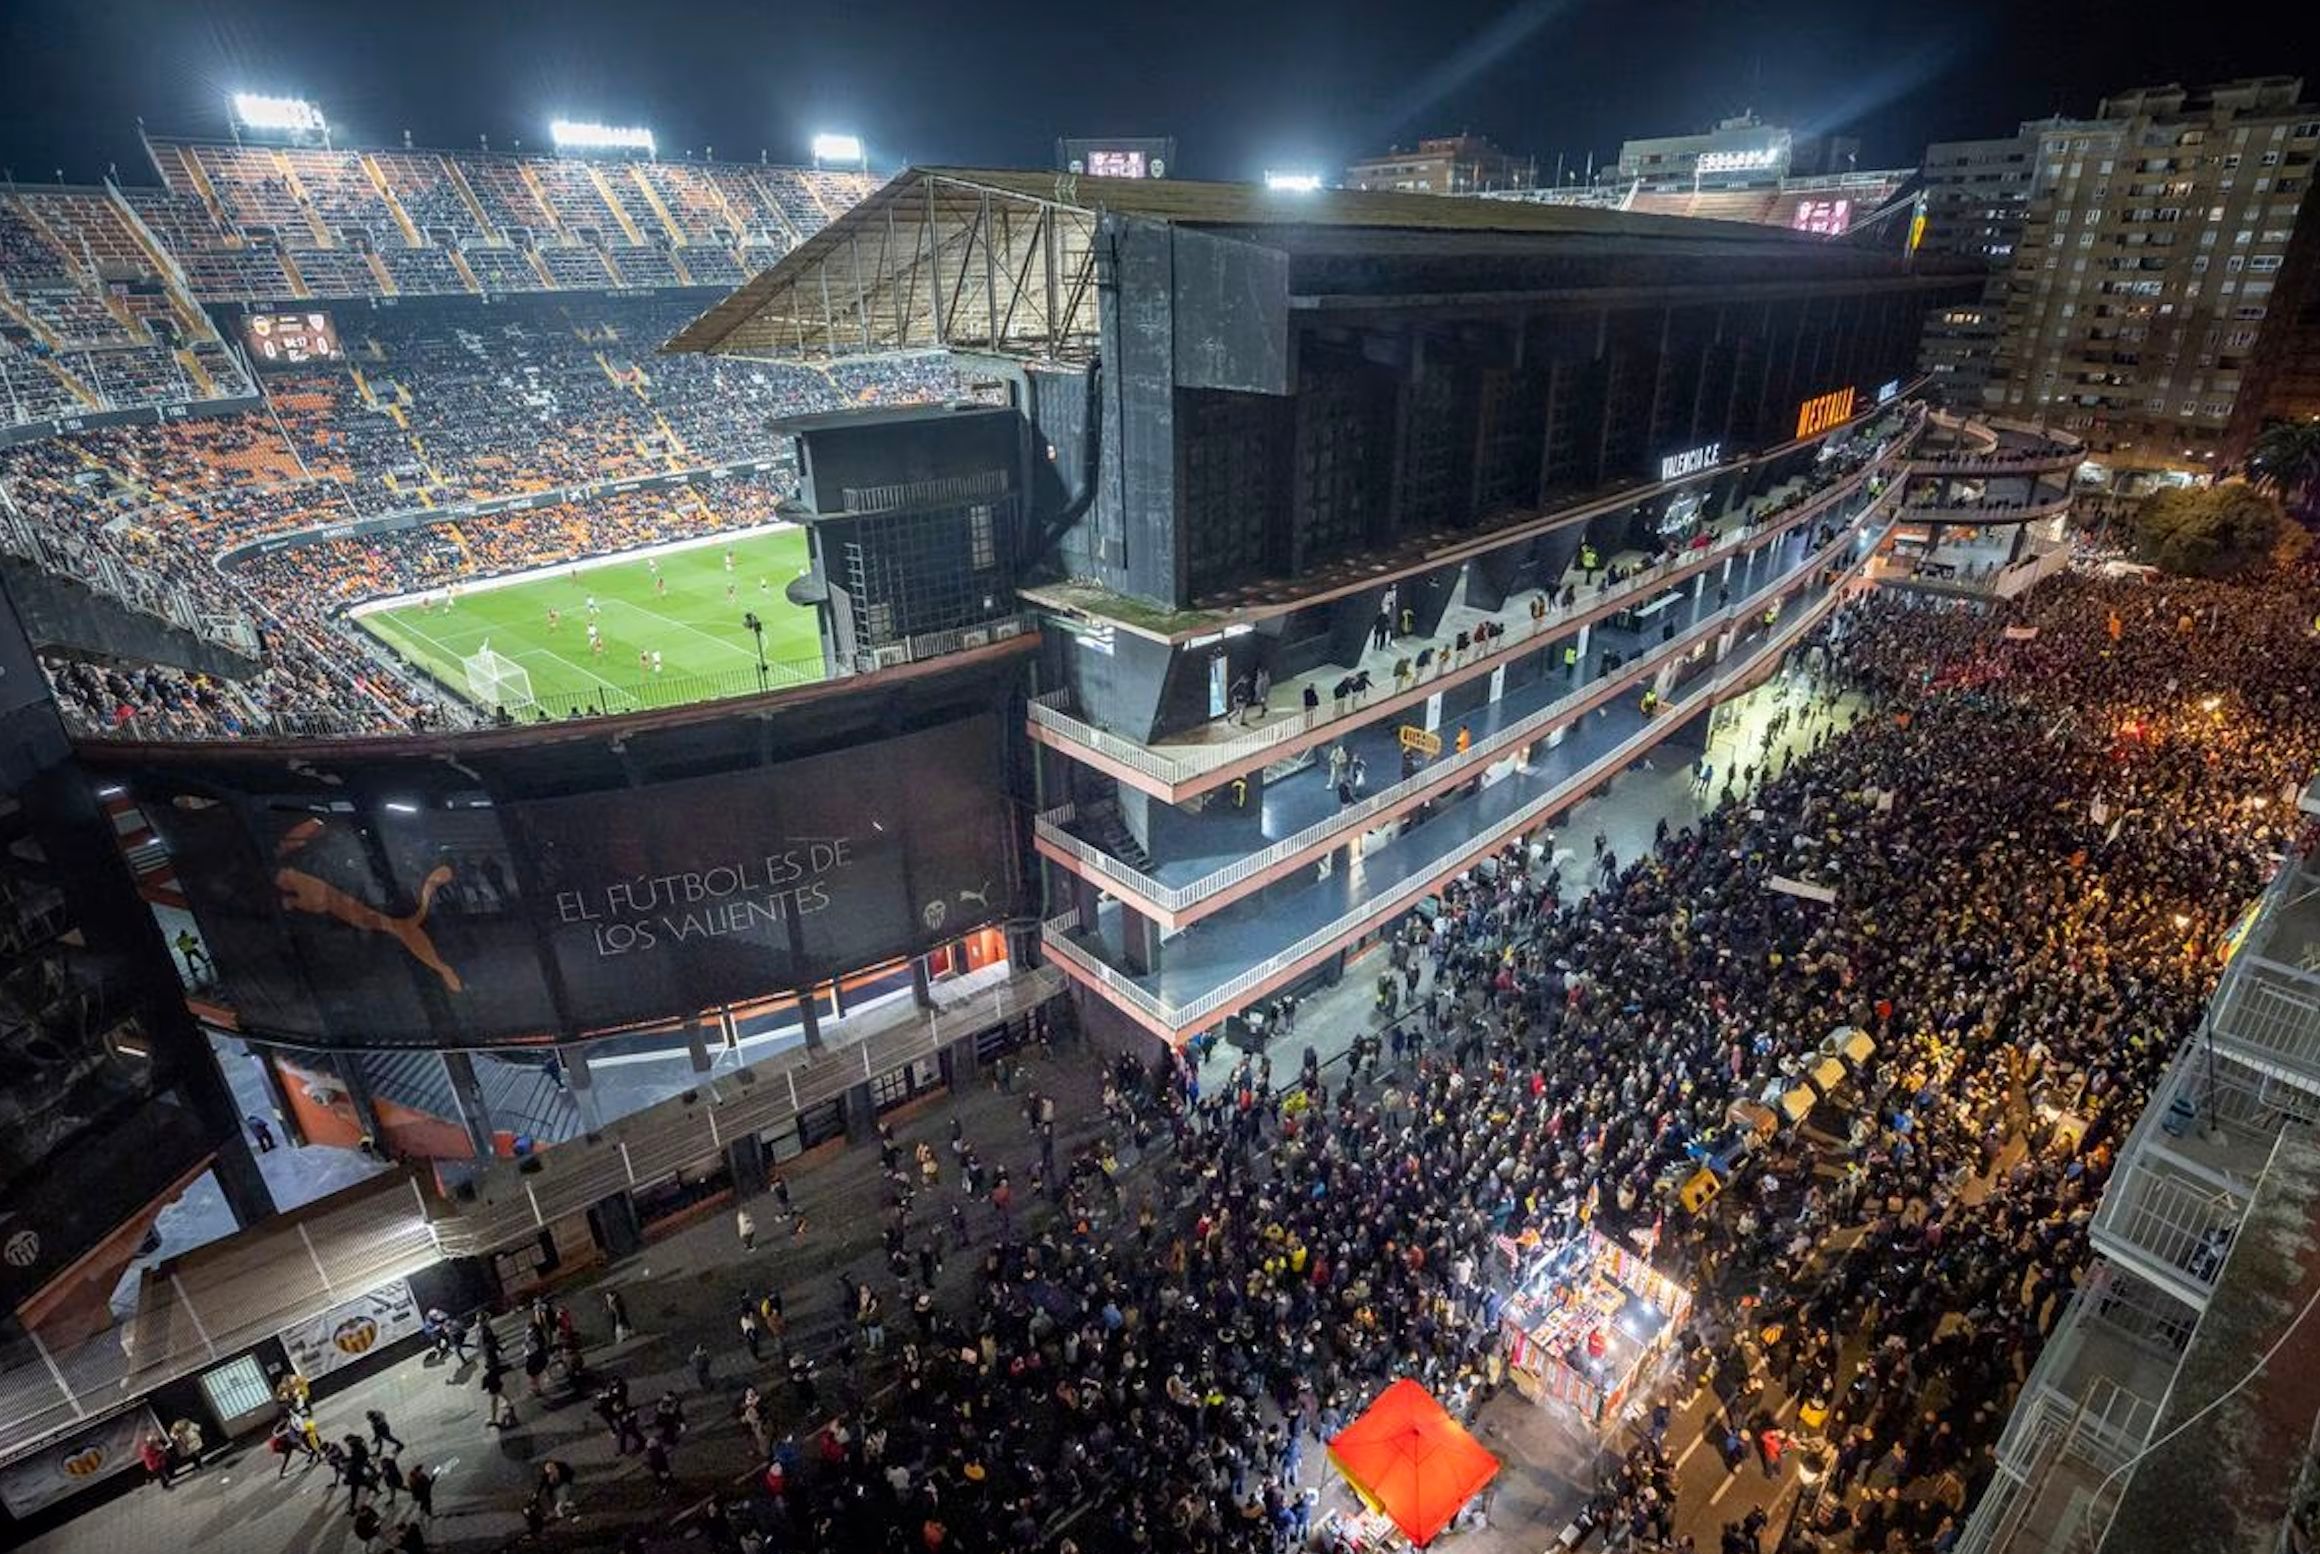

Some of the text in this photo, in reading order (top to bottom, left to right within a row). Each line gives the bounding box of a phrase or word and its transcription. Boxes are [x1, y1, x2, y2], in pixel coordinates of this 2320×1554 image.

[1796, 385, 1855, 439] MESTALLA
[1662, 447, 1703, 481] VALENCIA
[556, 838, 852, 922] EL FÚTBOL ES DE
[593, 881, 830, 956] LOS VALIENTES
